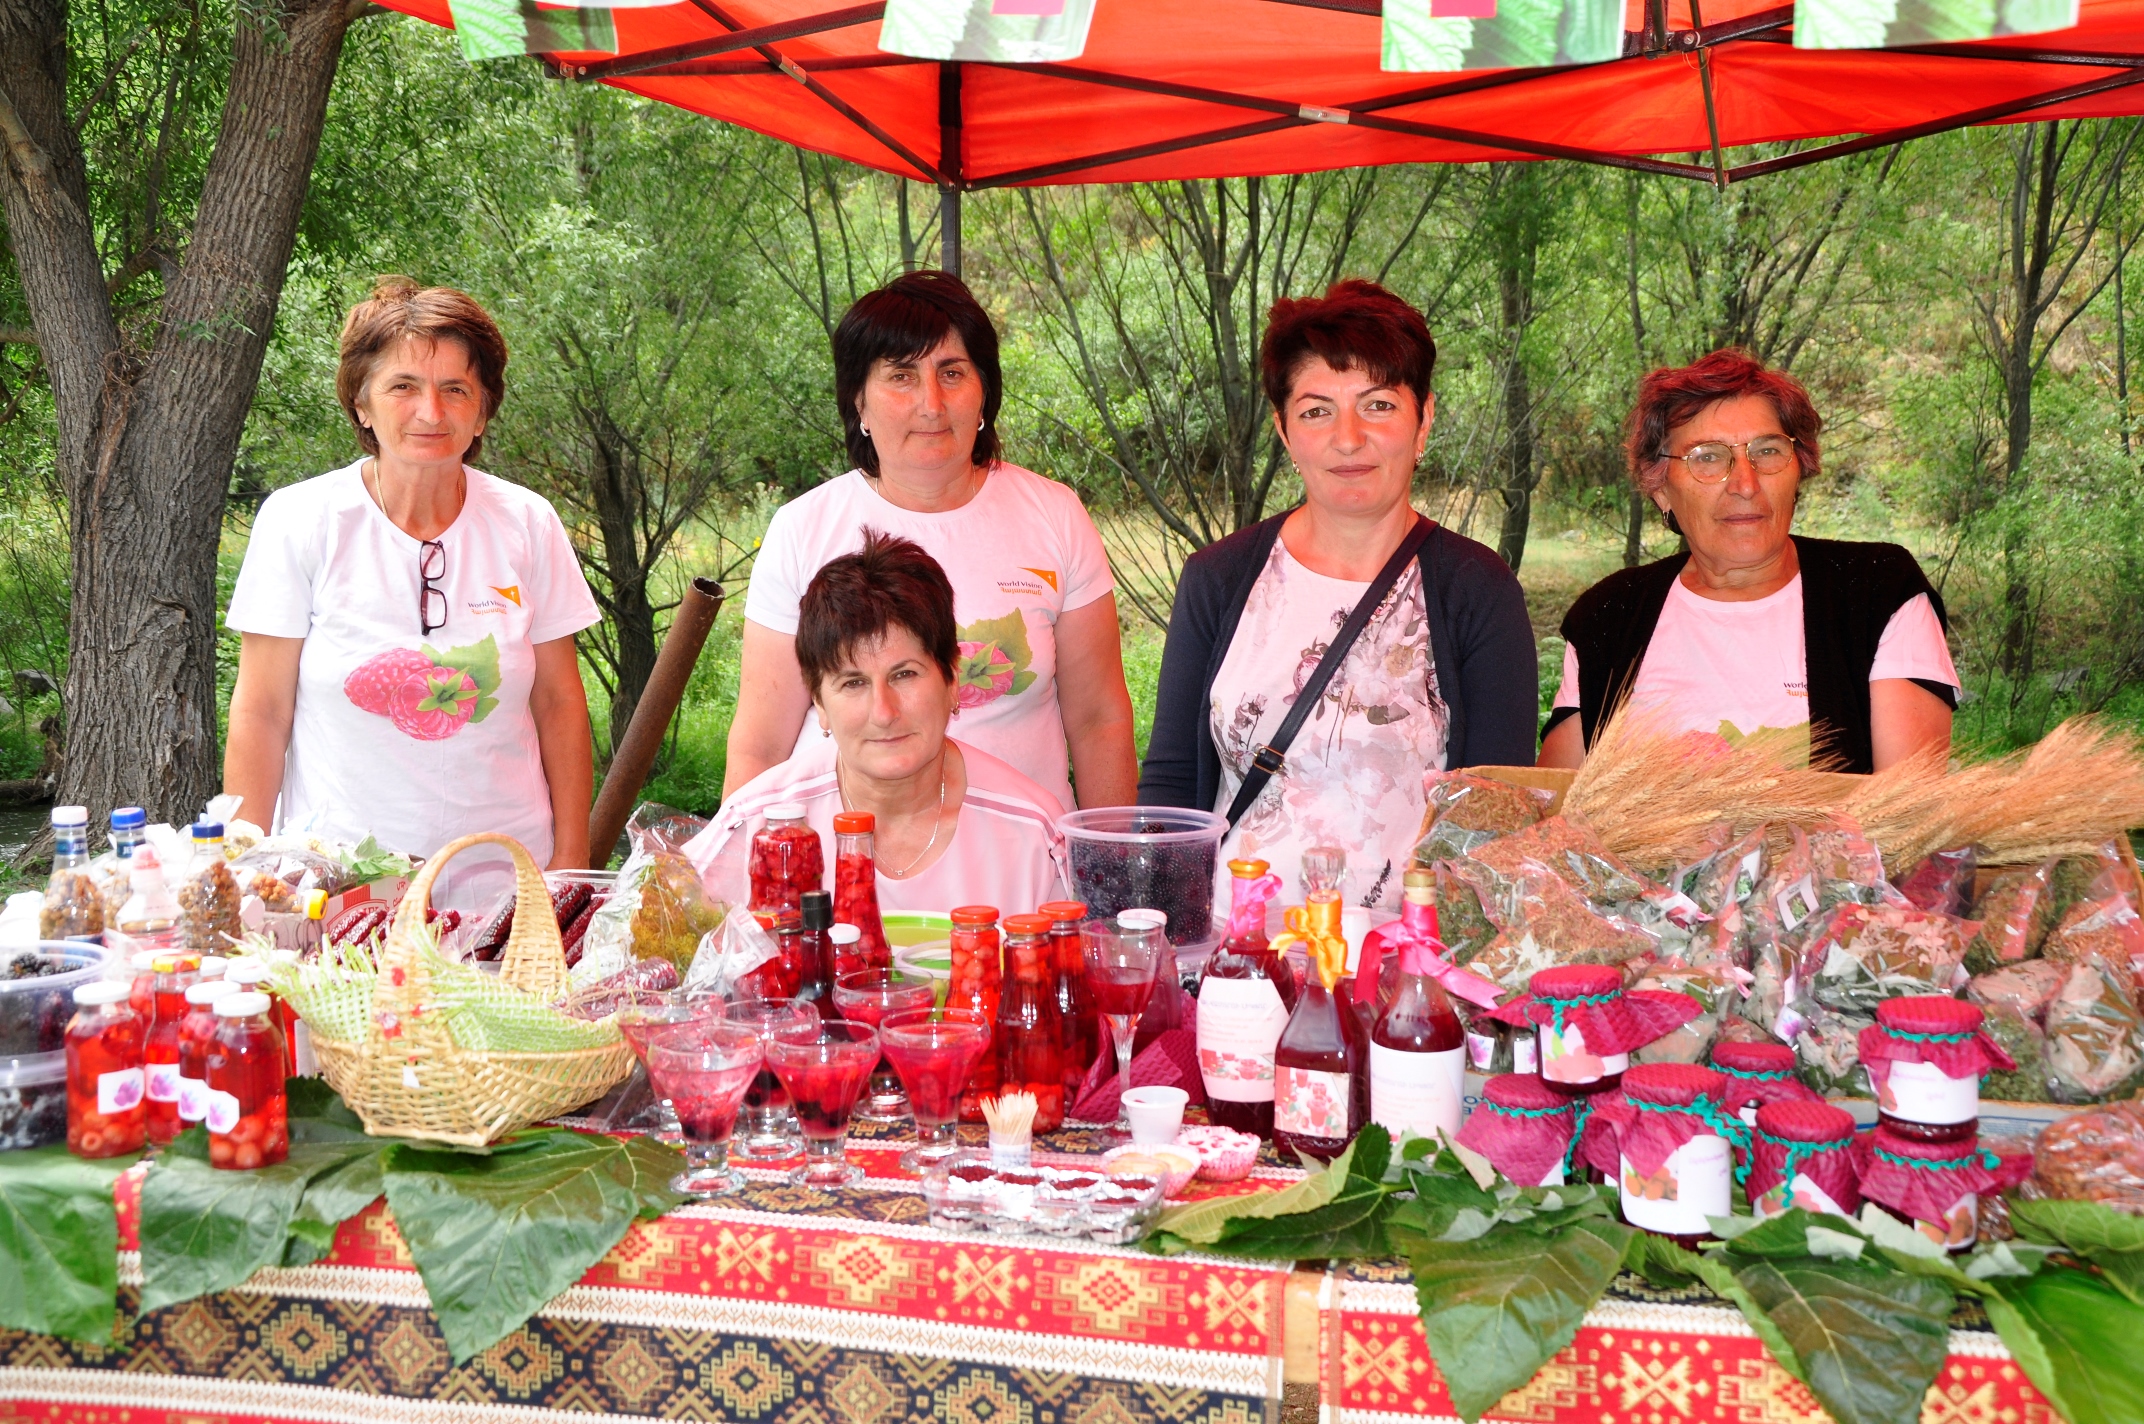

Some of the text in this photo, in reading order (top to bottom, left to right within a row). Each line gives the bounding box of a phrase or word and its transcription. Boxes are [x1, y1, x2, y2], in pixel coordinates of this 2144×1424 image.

[1021, 581, 1043, 590] Vision
[468, 600, 507, 608] World Vision
